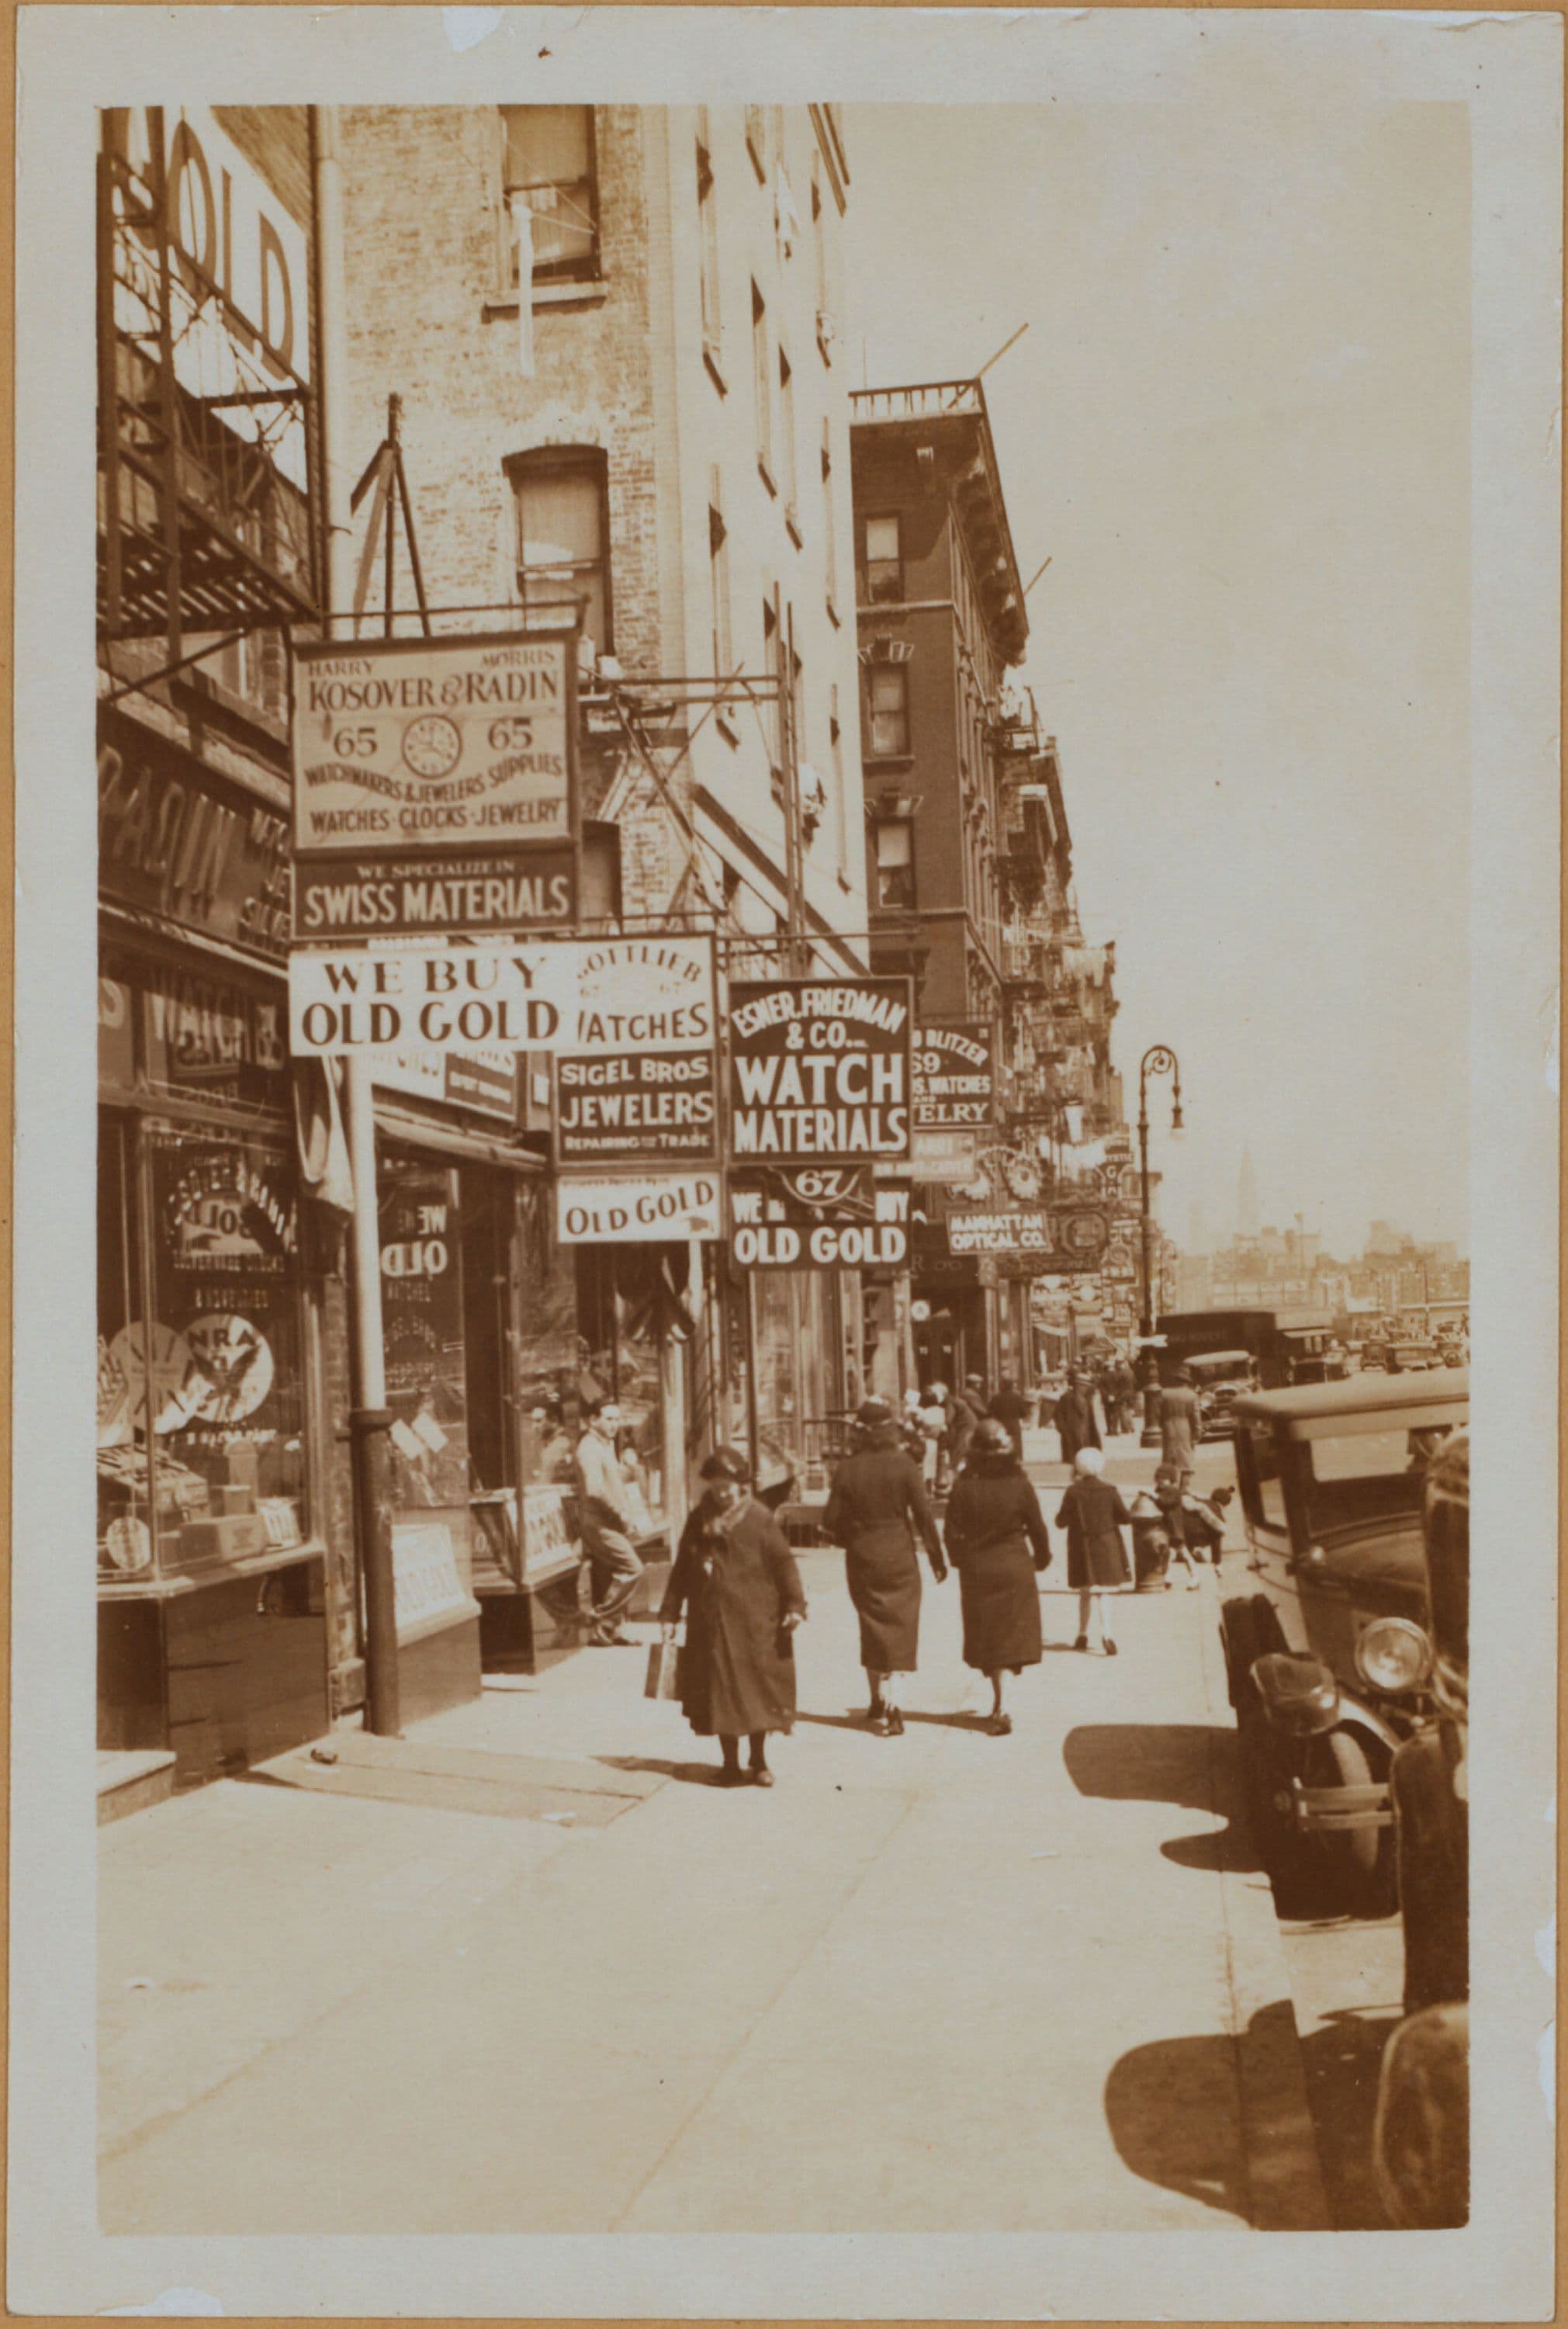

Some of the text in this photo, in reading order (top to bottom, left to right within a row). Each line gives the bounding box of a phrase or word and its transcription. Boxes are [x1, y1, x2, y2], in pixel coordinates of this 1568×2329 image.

[310, 659, 373, 678] HARRY
[481, 649, 556, 668] MORRIS
[310, 669, 559, 712] KOSOVER & RADIN
[334, 727, 379, 758] 65
[487, 716, 534, 751] 65
[487, 752, 562, 788] SUPPLIES
[311, 799, 560, 834] WATCHES CLOCKS JEWELRY
[356, 861, 515, 879] WE SPECIALIZE IN
[303, 875, 570, 927] SWISS MATERIALS
[324, 955, 546, 994] WE BUY
[302, 1002, 402, 1045] OLD
[419, 1000, 559, 1042] GOLD
[801, 987, 907, 1035] FRIEDMAN
[785, 1022, 805, 1050] &
[926, 1029, 989, 1068] BLITZER
[560, 1056, 708, 1086] SIGEL BROS
[734, 1053, 904, 1106] WATCH
[928, 1076, 991, 1094] WATCHES
[560, 1090, 715, 1128] JEWELERS
[564, 1135, 641, 1151] REPAIRING
[659, 1132, 709, 1149] TRADE
[733, 1108, 908, 1153] MATERIALS
[795, 1170, 844, 1197] 67
[565, 1180, 715, 1236] OLD GOLD
[732, 1190, 909, 1224] WE BUY
[950, 1215, 1044, 1232] MANHATTAN
[734, 1227, 801, 1263] OLD
[809, 1226, 906, 1263] GOLD
[951, 1233, 1019, 1251] OPTICAL
[188, 1327, 257, 1348] NRA
